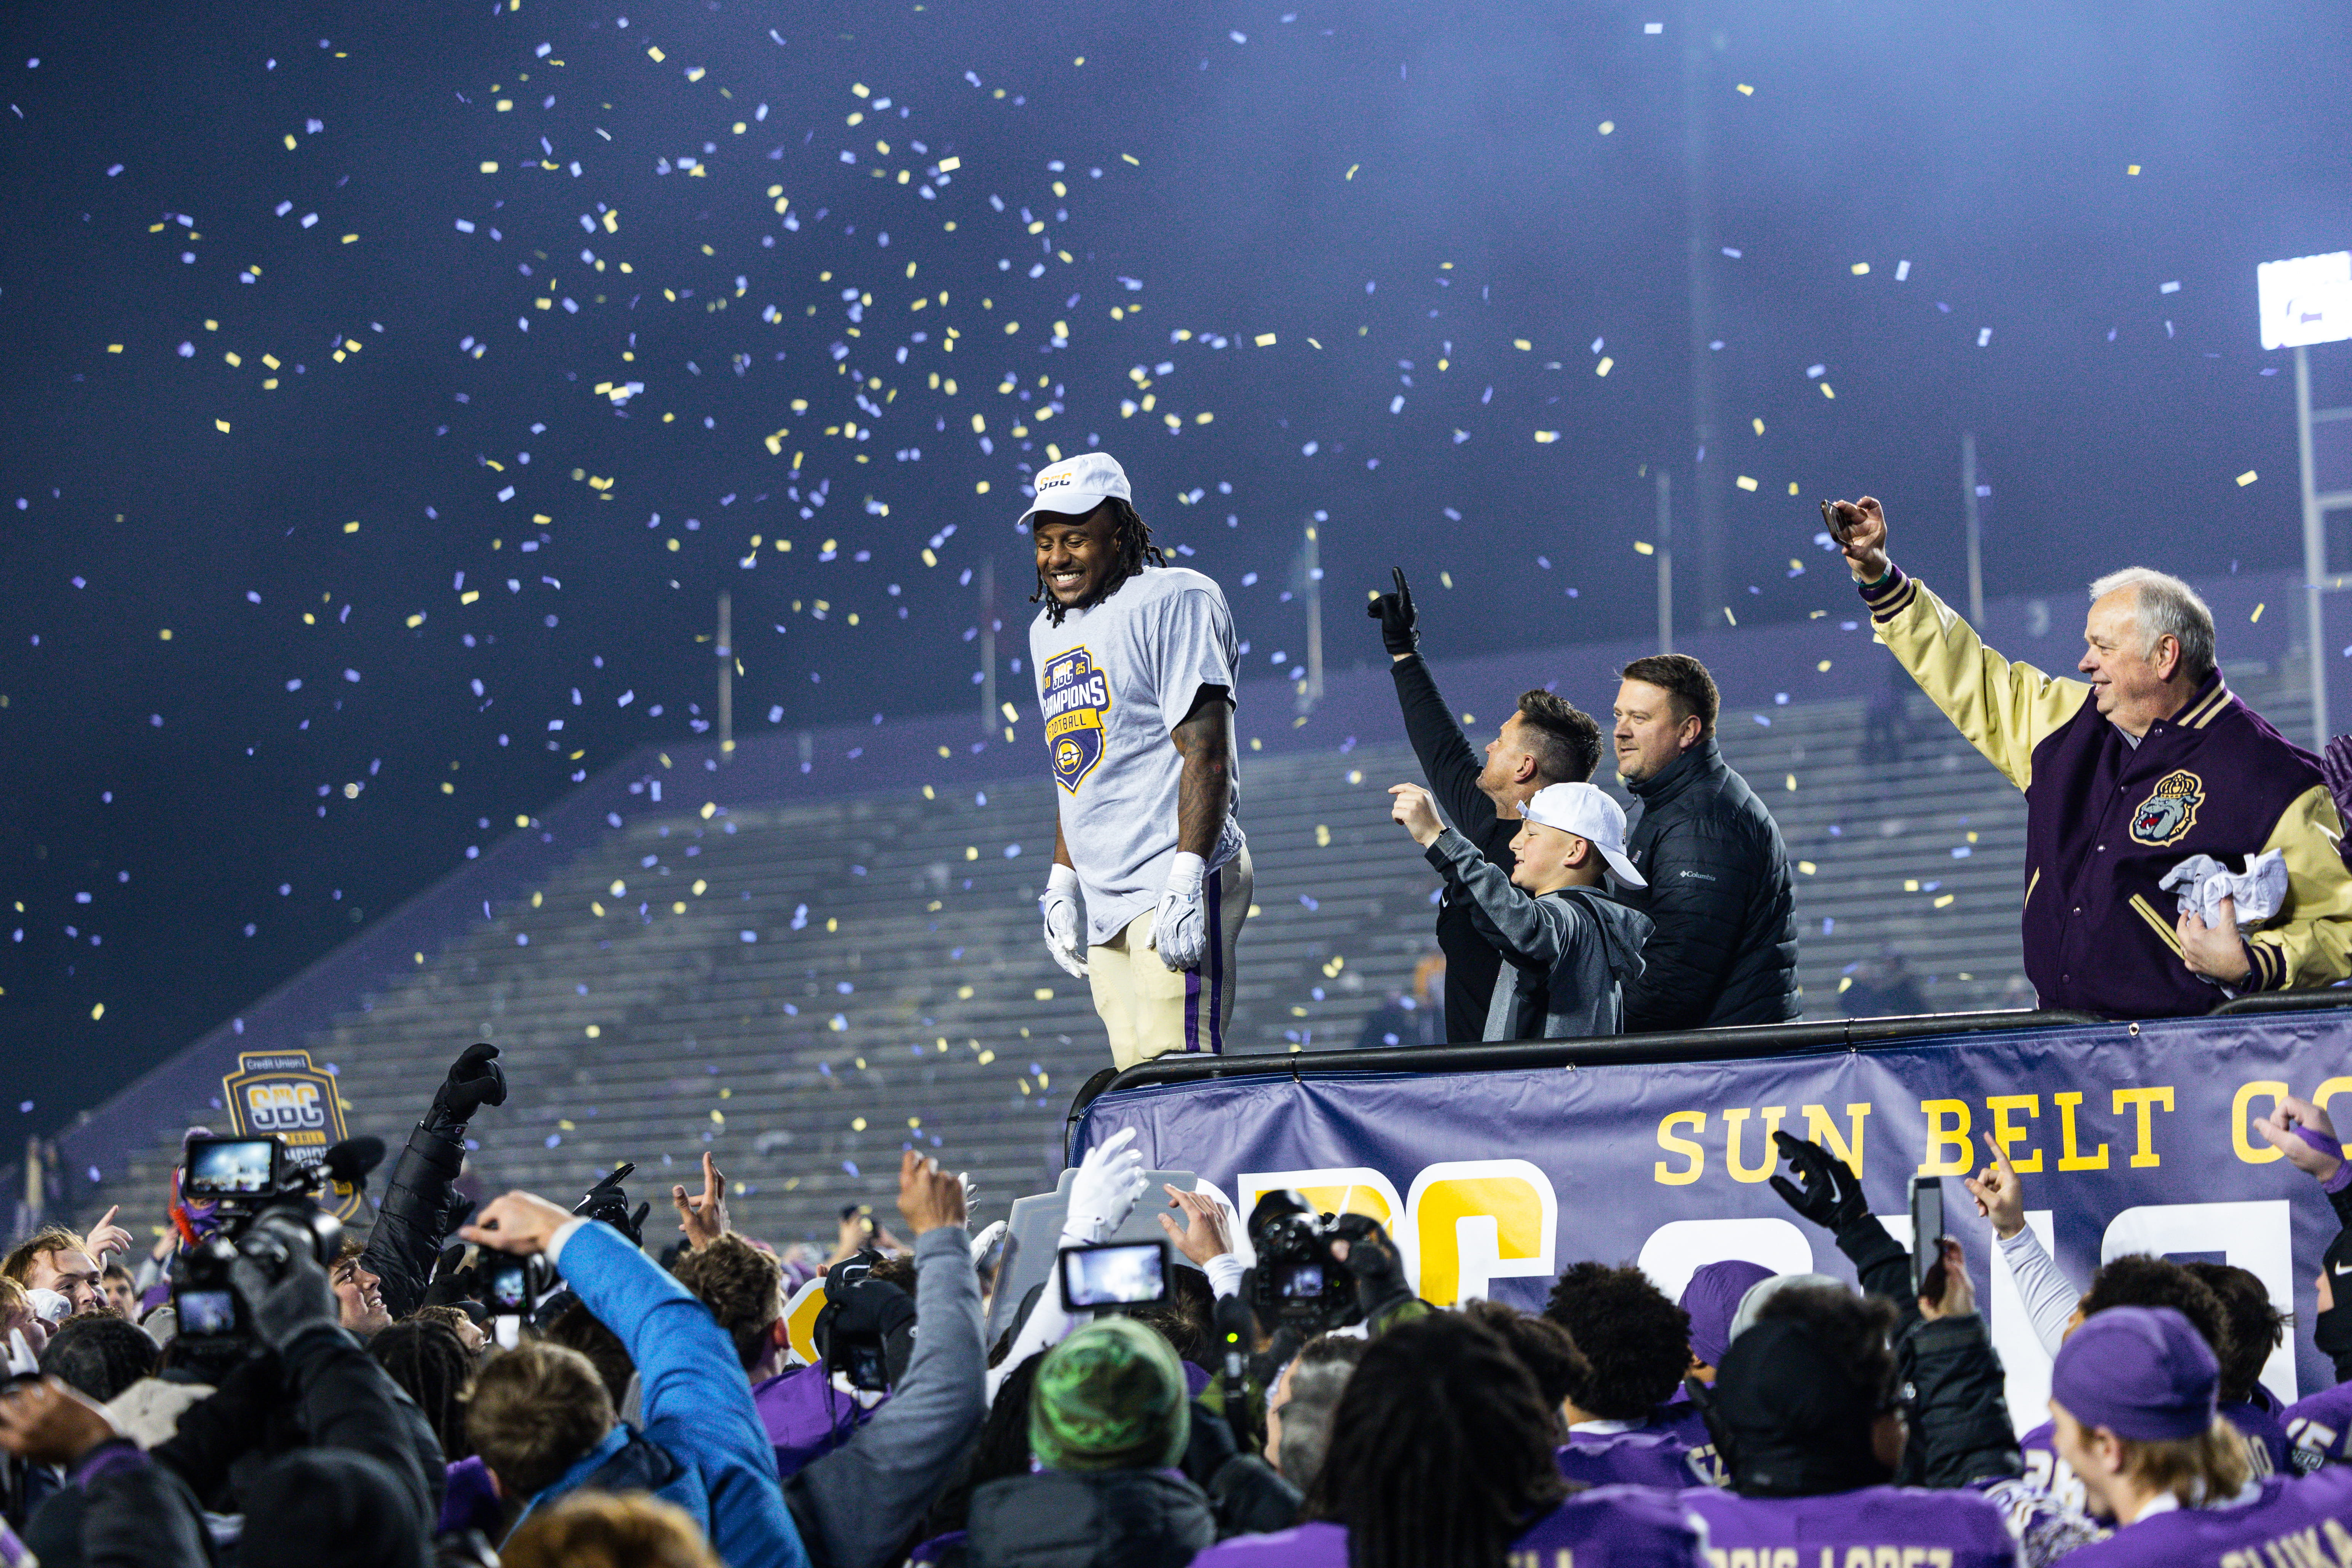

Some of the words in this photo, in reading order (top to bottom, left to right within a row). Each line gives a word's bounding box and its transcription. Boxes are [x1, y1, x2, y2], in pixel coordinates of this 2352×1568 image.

[1039, 473, 1072, 492] SBC
[1052, 659, 1073, 691] SBC
[1076, 661, 1086, 675] 25
[1043, 676, 1106, 722] CHAMPIONS
[1048, 713, 1086, 739] FOOTBALL
[1687, 871, 1716, 881] Columbia
[246, 1058, 273, 1070] Credit
[247, 1082, 325, 1130] SBC
[1654, 1102, 1871, 1186] SUN
[1918, 1086, 2174, 1177] BELT
